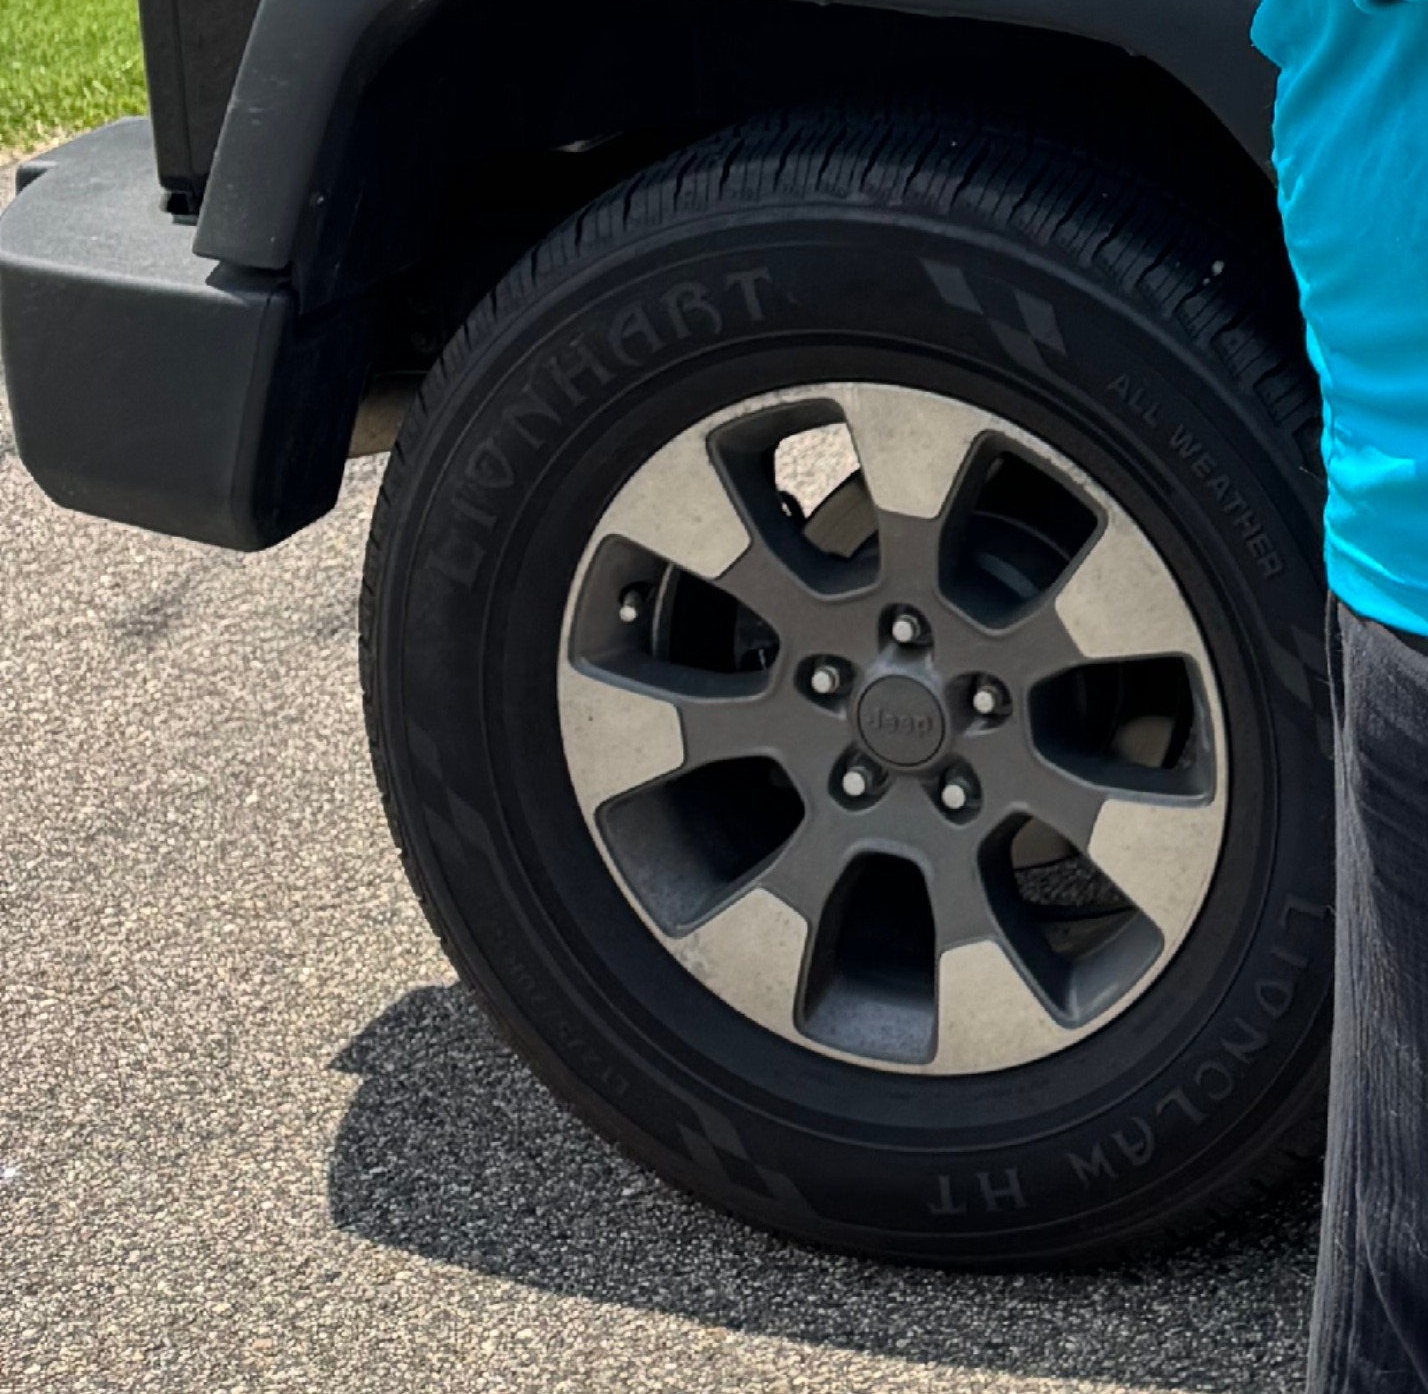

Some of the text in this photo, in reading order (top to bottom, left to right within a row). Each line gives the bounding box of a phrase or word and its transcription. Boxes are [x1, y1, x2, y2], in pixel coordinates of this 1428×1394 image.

[423, 265, 774, 592] LIONHART
[1107, 372, 1286, 581] ALL WEATHER
[864, 705, 935, 739] Jeep
[926, 893, 1328, 1216] LIONCLAW HT
